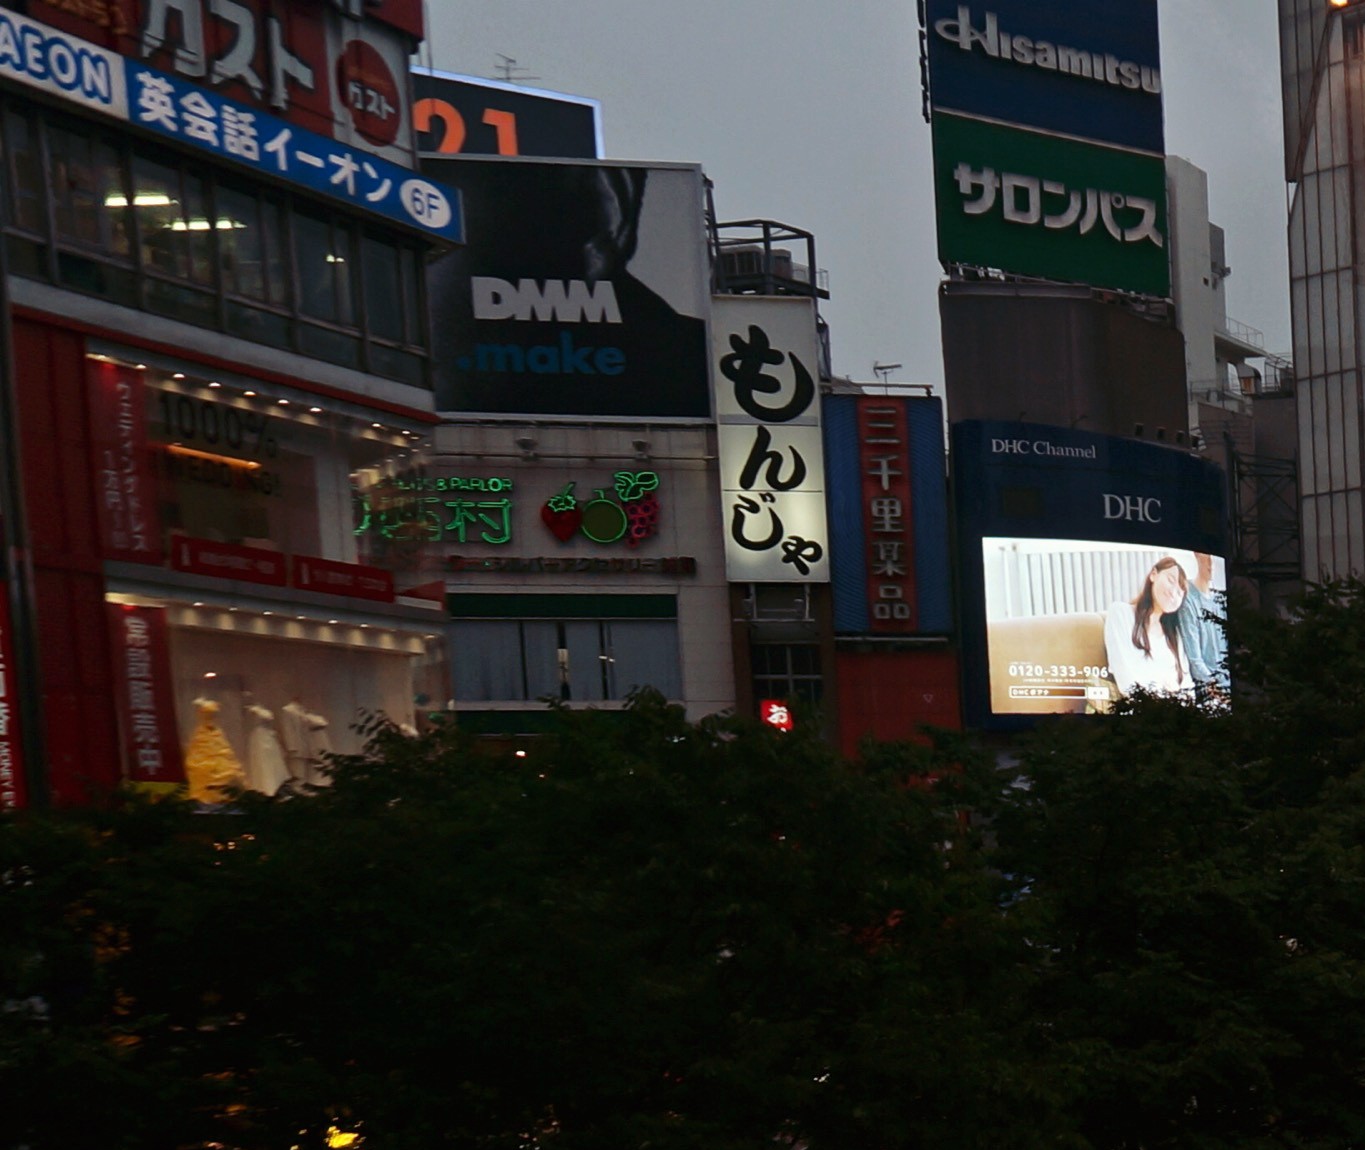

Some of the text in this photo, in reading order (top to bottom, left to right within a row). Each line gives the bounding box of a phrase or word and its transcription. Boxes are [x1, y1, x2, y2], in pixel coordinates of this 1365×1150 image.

[0, 20, 111, 101] AEON
[934, 4, 1160, 93] Hisamitsu
[348, 79, 395, 121] ガスト
[134, 70, 440, 222] 英会話イーオン 6F
[953, 161, 1163, 248] サロンパス
[471, 276, 623, 324] DMM
[456, 331, 627, 375] .make
[719, 324, 823, 576] もんじゃ
[991, 437, 1097, 459] DHC Channel
[1101, 493, 1162, 523] DHC
[1008, 664, 1109, 679] 0120-333-906
